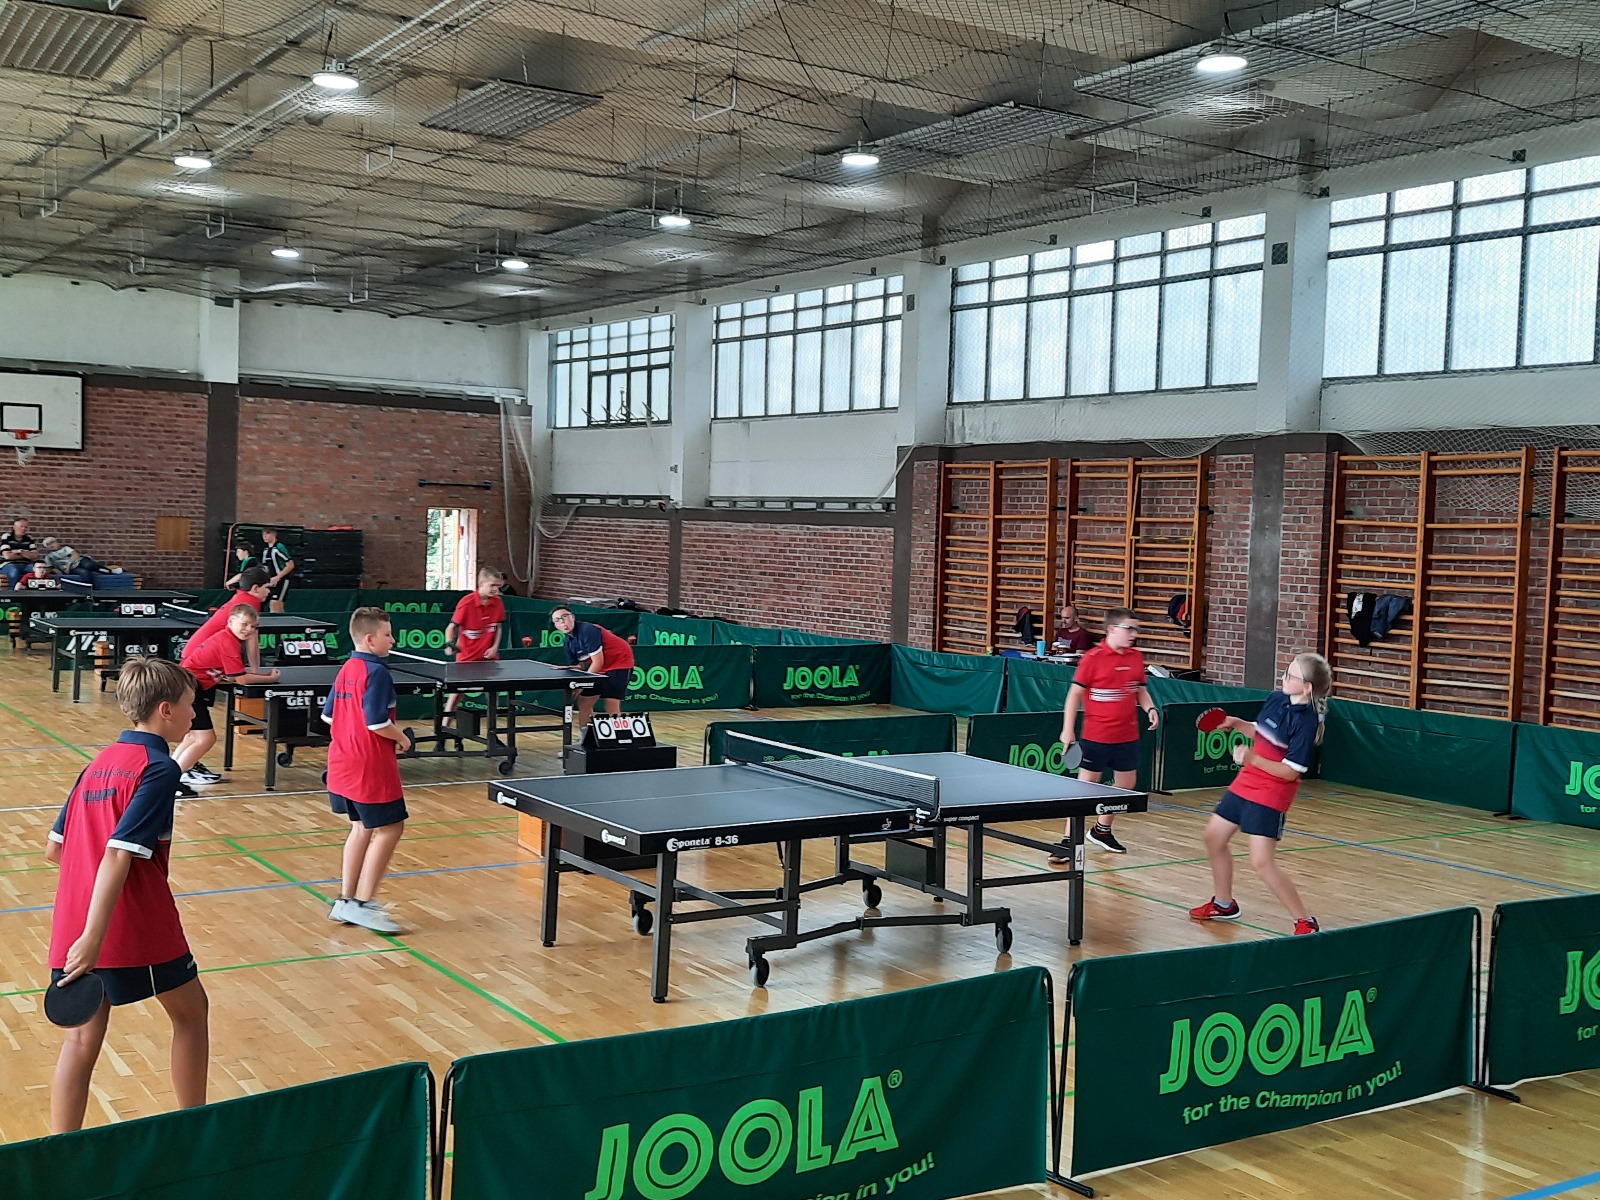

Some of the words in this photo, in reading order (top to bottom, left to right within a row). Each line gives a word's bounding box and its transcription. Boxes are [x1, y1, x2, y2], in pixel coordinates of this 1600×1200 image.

[783, 665, 859, 690] JOOLA
[649, 693, 690, 704] Champion
[598, 720, 612, 738] 0
[632, 719, 646, 736] 0
[1580, 804, 1598, 813] for
[666, 837, 711, 852] Sponeta
[715, 834, 739, 846] 8-36
[1159, 989, 1375, 1094] JOOLA
[1577, 1024, 1599, 1041] for
[1182, 1105, 1213, 1125] for
[1218, 1094, 1251, 1113] the
[1255, 1090, 1343, 1111] Champion
[1346, 1084, 1363, 1101] in
[1366, 1060, 1403, 1096] you!
[585, 1076, 899, 1200] JOOLA
[855, 1182, 878, 1200] in
[883, 1151, 937, 1195] you!
